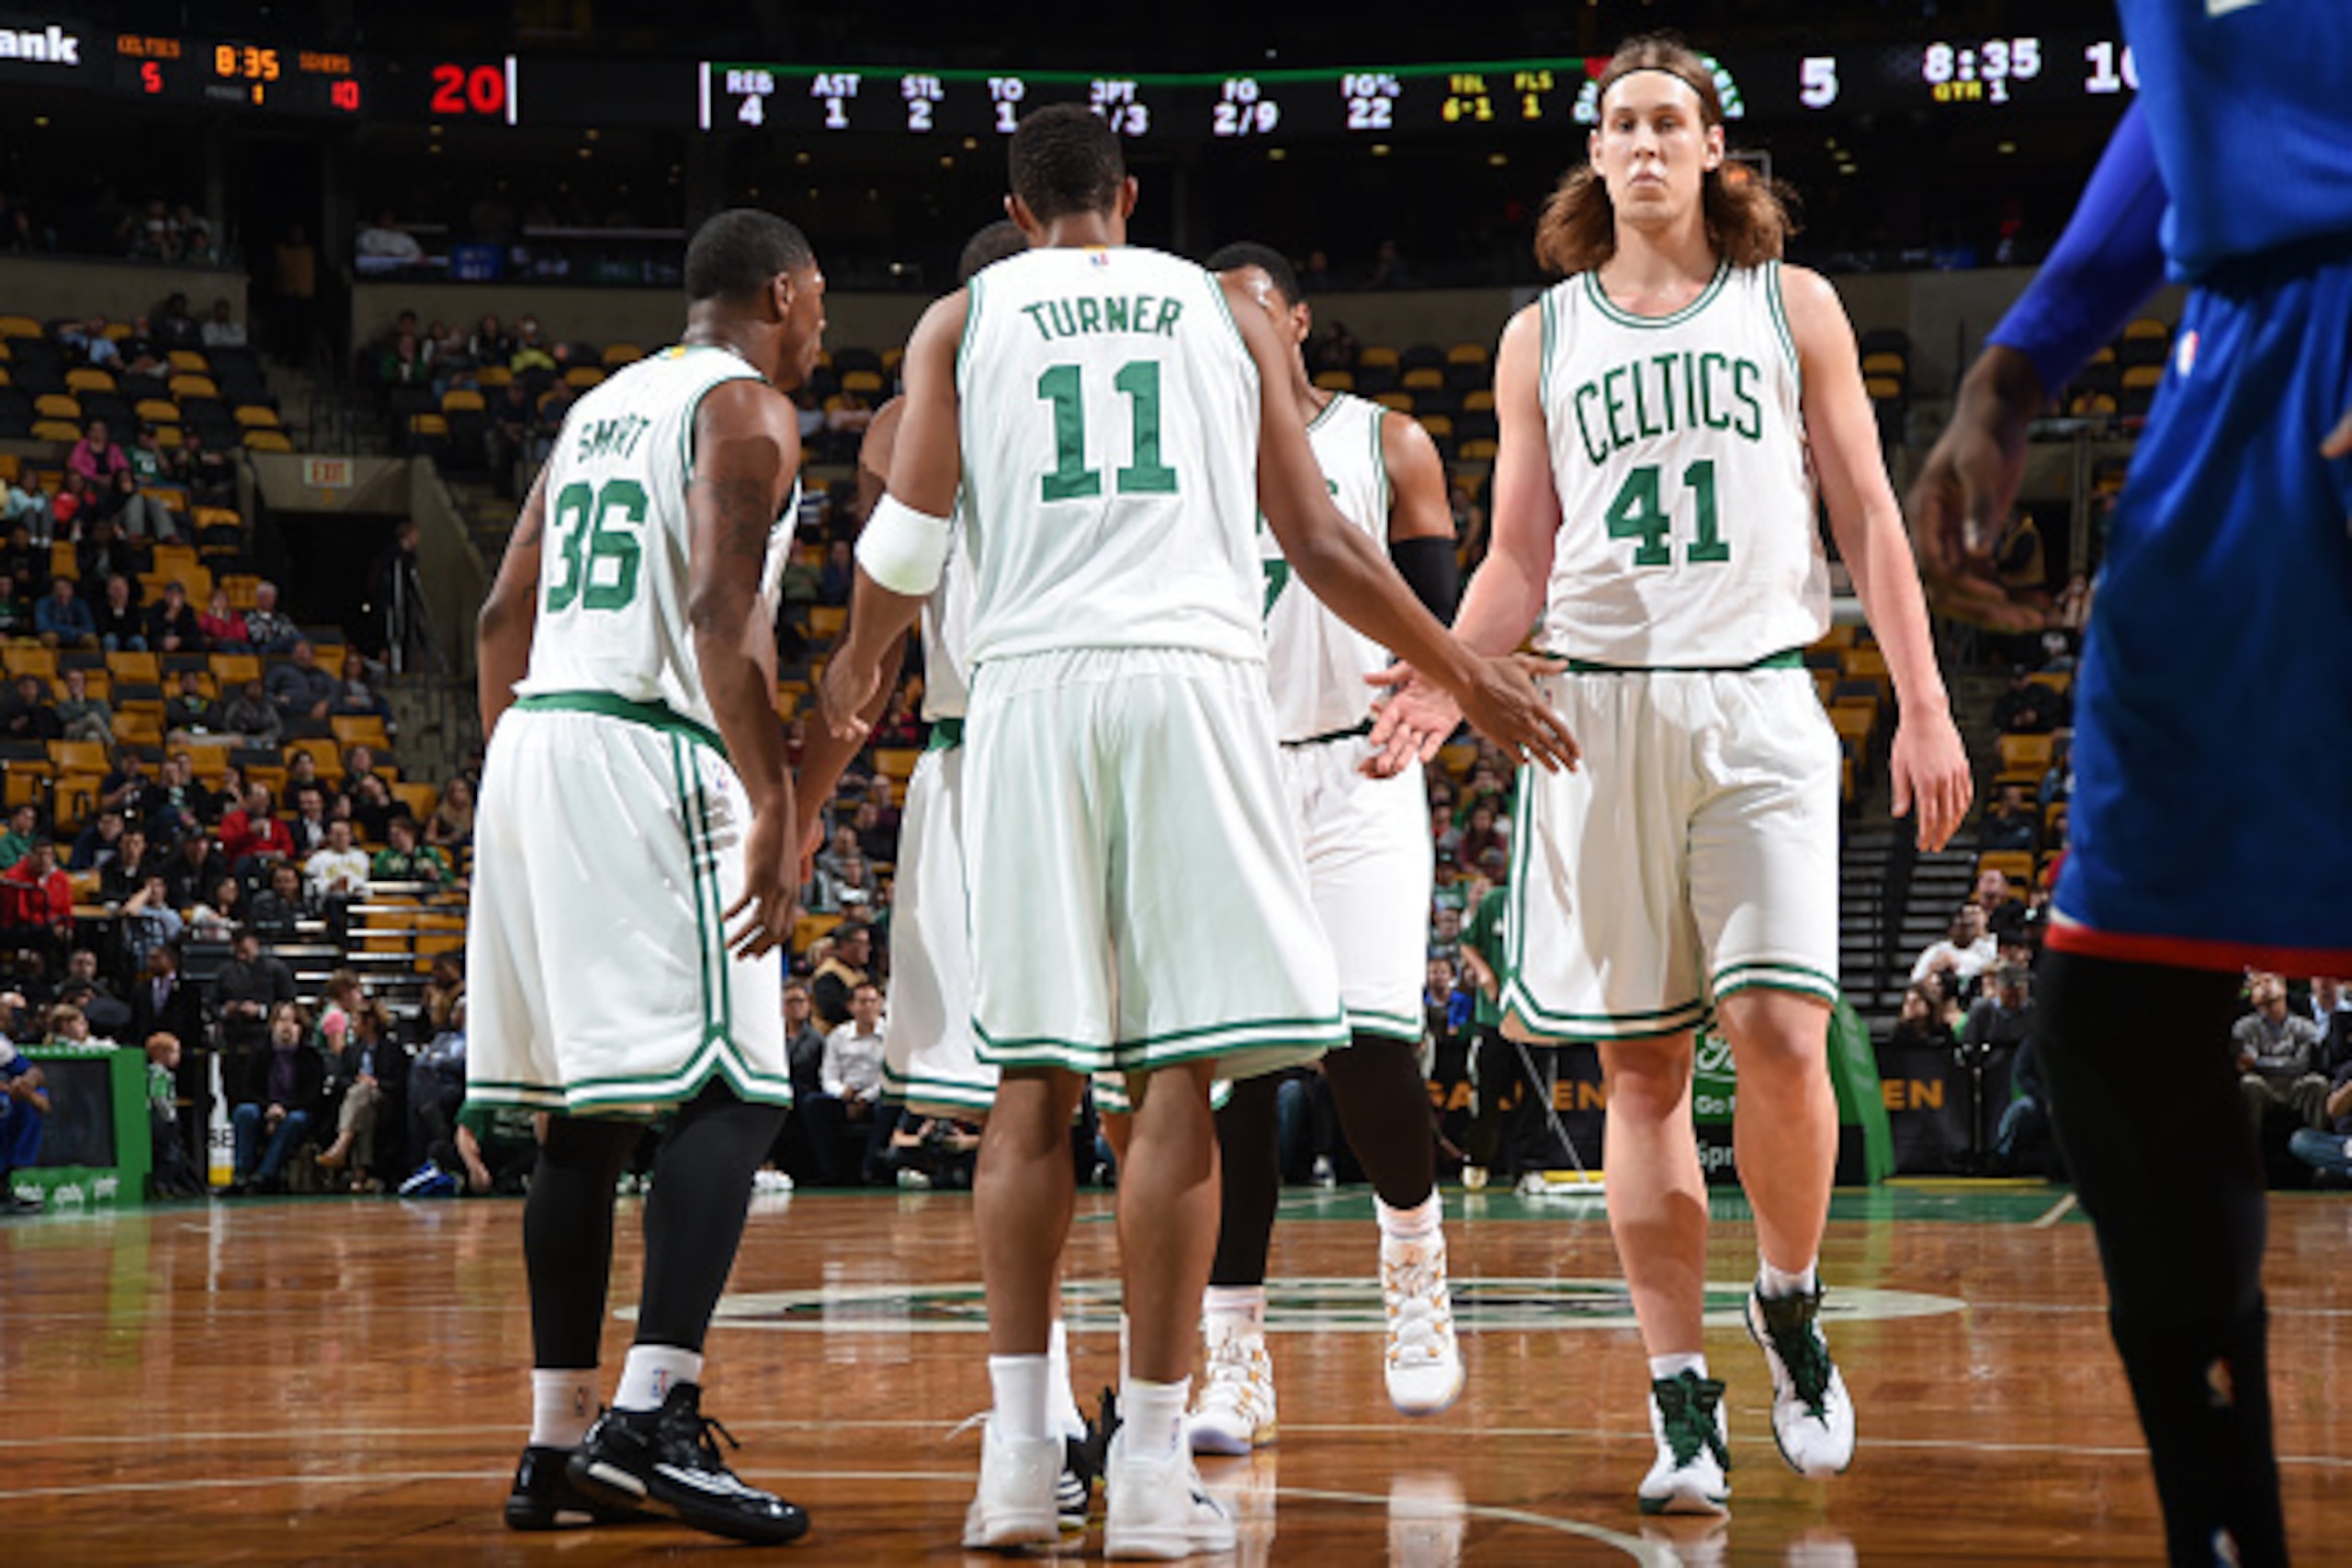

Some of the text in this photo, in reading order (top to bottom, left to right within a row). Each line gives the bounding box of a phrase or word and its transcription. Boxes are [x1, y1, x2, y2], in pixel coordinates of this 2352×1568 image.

[141, 61, 164, 93] 5
[216, 45, 279, 81] 8:35
[1923, 38, 2041, 84] 8:35
[430, 62, 504, 113] 20
[726, 70, 775, 95] REB
[811, 73, 860, 97] AST
[901, 74, 944, 101] STL
[988, 77, 1024, 102] TO
[1090, 78, 1137, 104] 3PT
[1514, 70, 1553, 90] FLS
[1801, 57, 1838, 107] 5
[1933, 80, 2008, 102] QTR 1
[739, 95, 763, 126] 4
[826, 96, 849, 129] 1
[908, 99, 933, 130] 2
[996, 101, 1018, 132] 1
[1213, 101, 1279, 136] 2/9
[1348, 96, 1393, 130] 22
[1522, 93, 1542, 119] 1
[1022, 295, 1182, 341] TURNER
[1575, 352, 1762, 466] CELTICS
[1037, 362, 1177, 502] 11
[1605, 459, 1730, 566] 41
[547, 478, 649, 614] 36
